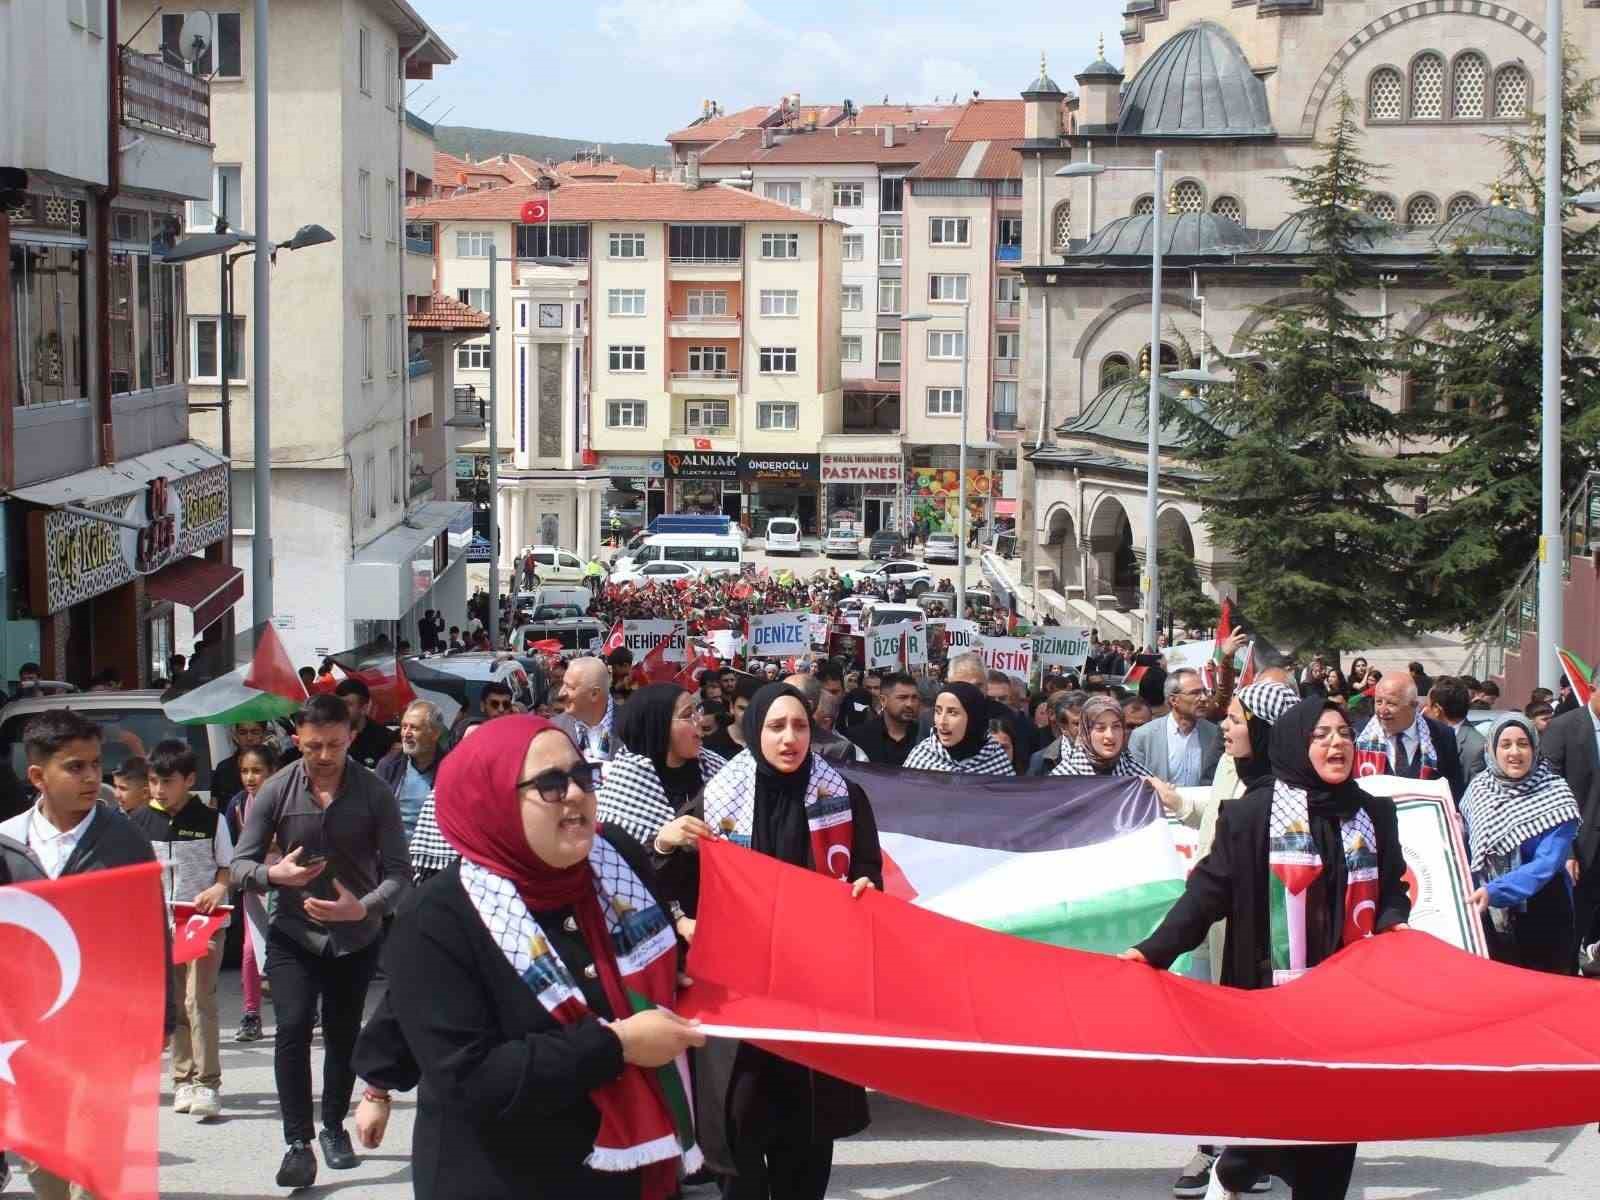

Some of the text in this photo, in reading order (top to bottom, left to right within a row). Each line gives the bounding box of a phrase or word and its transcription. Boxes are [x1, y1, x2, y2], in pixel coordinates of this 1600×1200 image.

[682, 455, 736, 466] ALNIAK
[749, 459, 808, 470] ÖNDEROĞLU
[822, 464, 901, 479] PASTANESİ
[754, 623, 803, 644] DENİZE
[874, 636, 918, 657] ÖZGR
